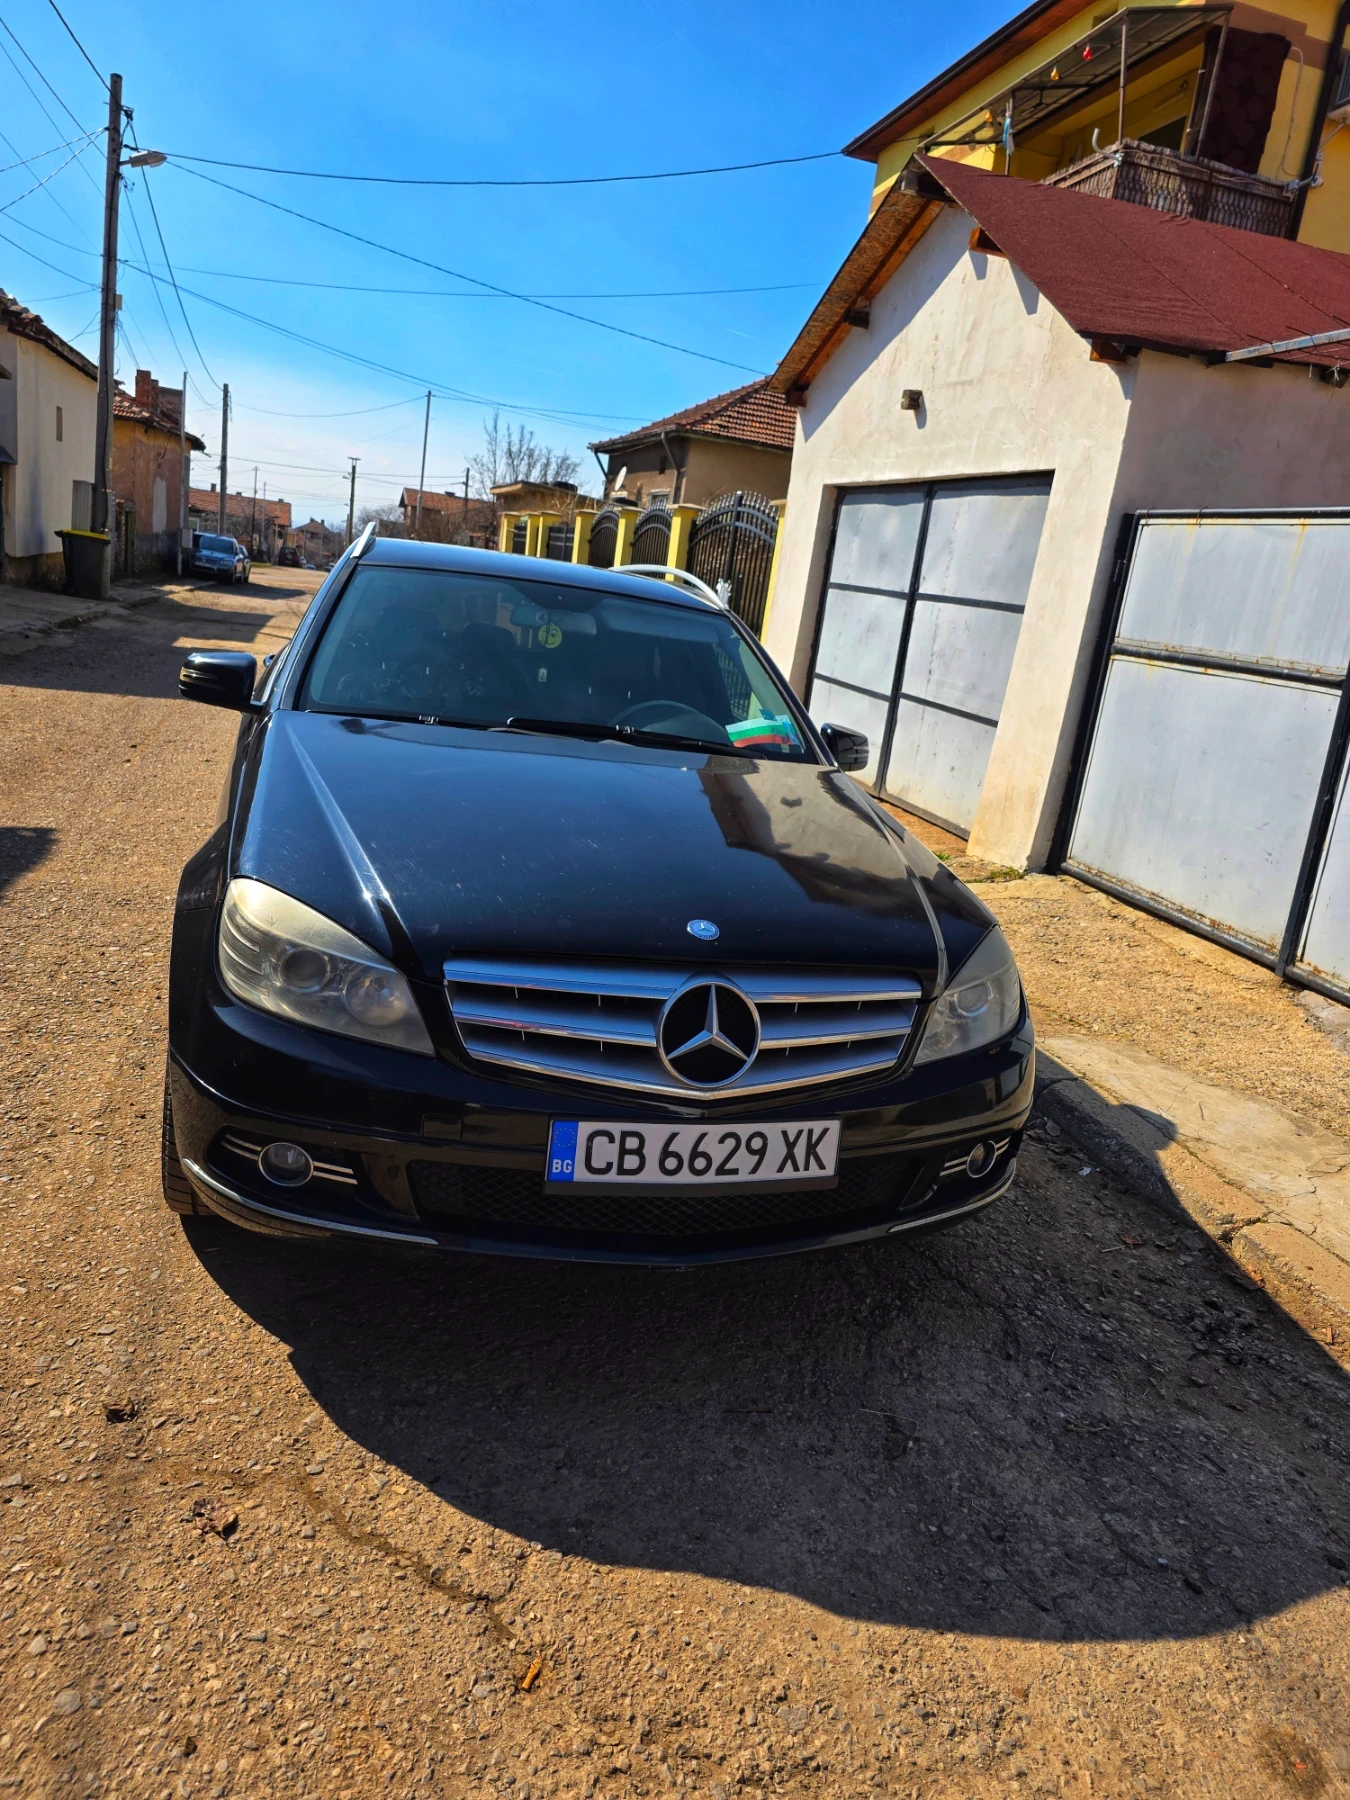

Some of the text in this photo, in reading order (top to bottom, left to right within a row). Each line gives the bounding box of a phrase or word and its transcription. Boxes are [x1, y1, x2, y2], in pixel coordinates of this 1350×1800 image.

[552, 1159, 572, 1173] BG
[584, 1127, 830, 1177] CB 6629 XK
